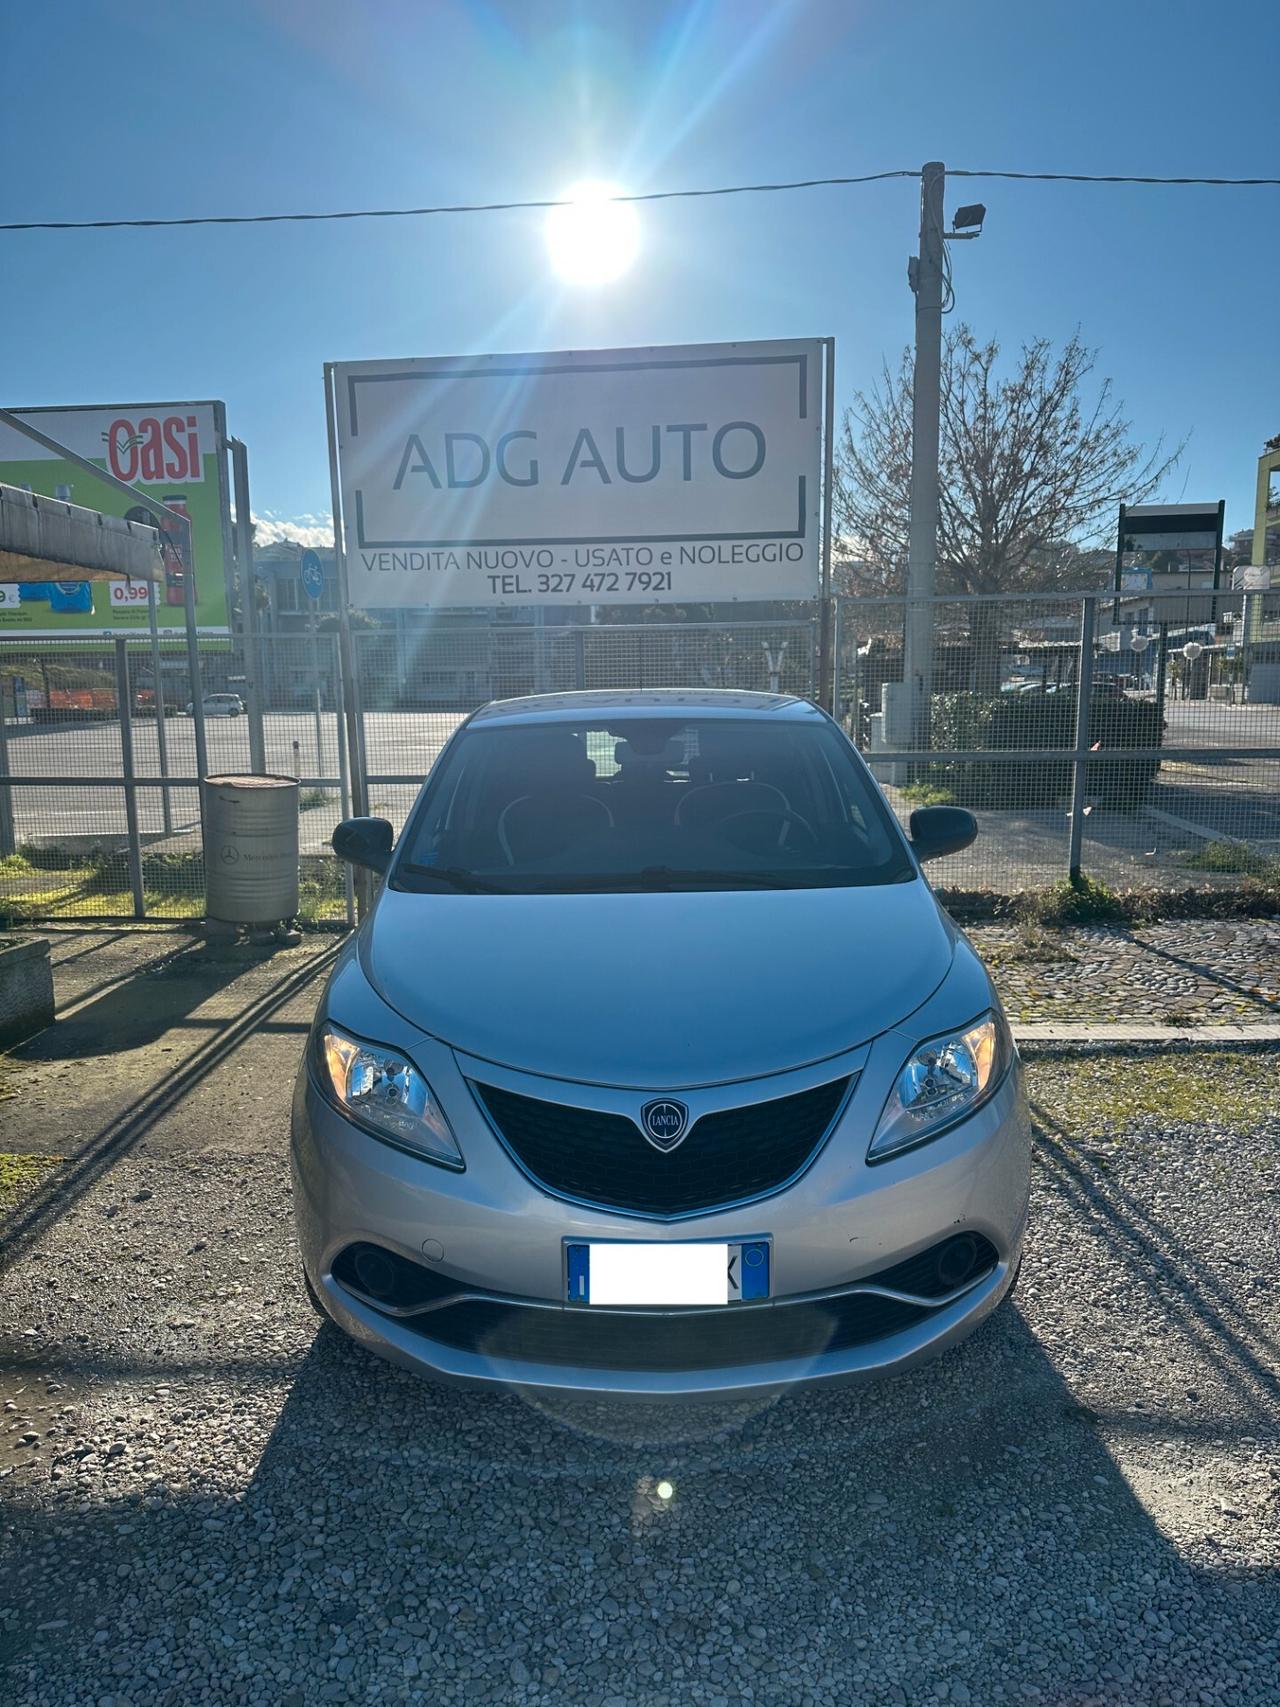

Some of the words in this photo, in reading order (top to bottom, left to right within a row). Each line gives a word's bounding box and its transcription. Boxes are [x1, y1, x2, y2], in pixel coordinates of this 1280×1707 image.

[392, 430, 539, 490] ADG
[560, 421, 767, 486] AUTO
[361, 550, 462, 572] VENDITA
[467, 548, 555, 571] NUOVO
[574, 547, 654, 569] USATO
[661, 552, 673, 566] e
[679, 543, 805, 566] NOLEGGIO
[487, 574, 533, 595] TEL.
[537, 573, 575, 594] 327
[582, 572, 619, 592] 472
[625, 571, 673, 592] 7921
[113, 587, 149, 604] 0,99
[652, 1114, 679, 1126] LANCIA
